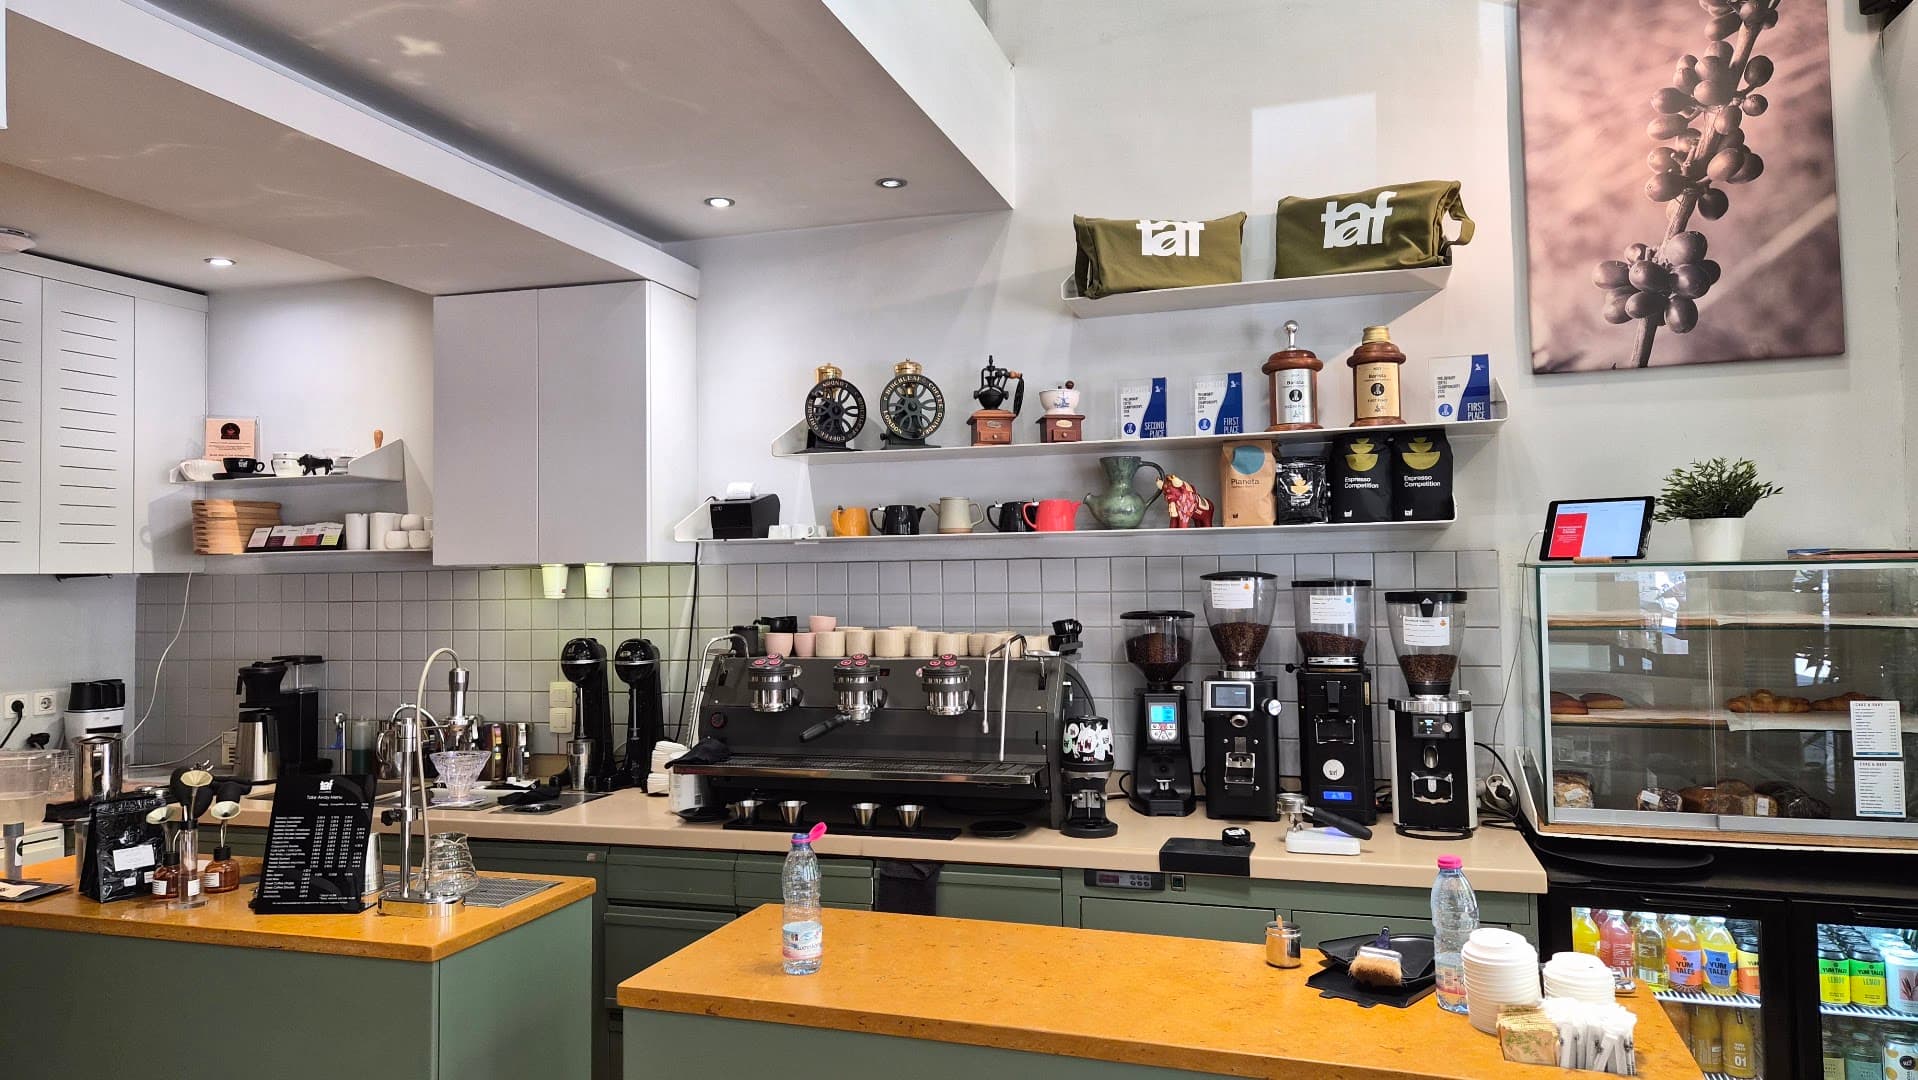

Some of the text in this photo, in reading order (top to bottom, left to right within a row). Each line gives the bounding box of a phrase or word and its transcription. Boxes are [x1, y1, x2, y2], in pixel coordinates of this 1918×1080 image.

[1321, 191, 1397, 249] taf
[1467, 402, 1485, 412] FIRST
[1467, 411, 1486, 420] PLACE
[1144, 421, 1165, 431] SECOND
[1223, 417, 1240, 426] FIRST
[1149, 429, 1165, 438] PLACE
[1223, 425, 1240, 434] PLACE
[1709, 961, 1727, 969] YUM
[1675, 967, 1695, 975] TALES
[1708, 967, 1729, 976] TALES
[1734, 1055, 1747, 1067] 01
